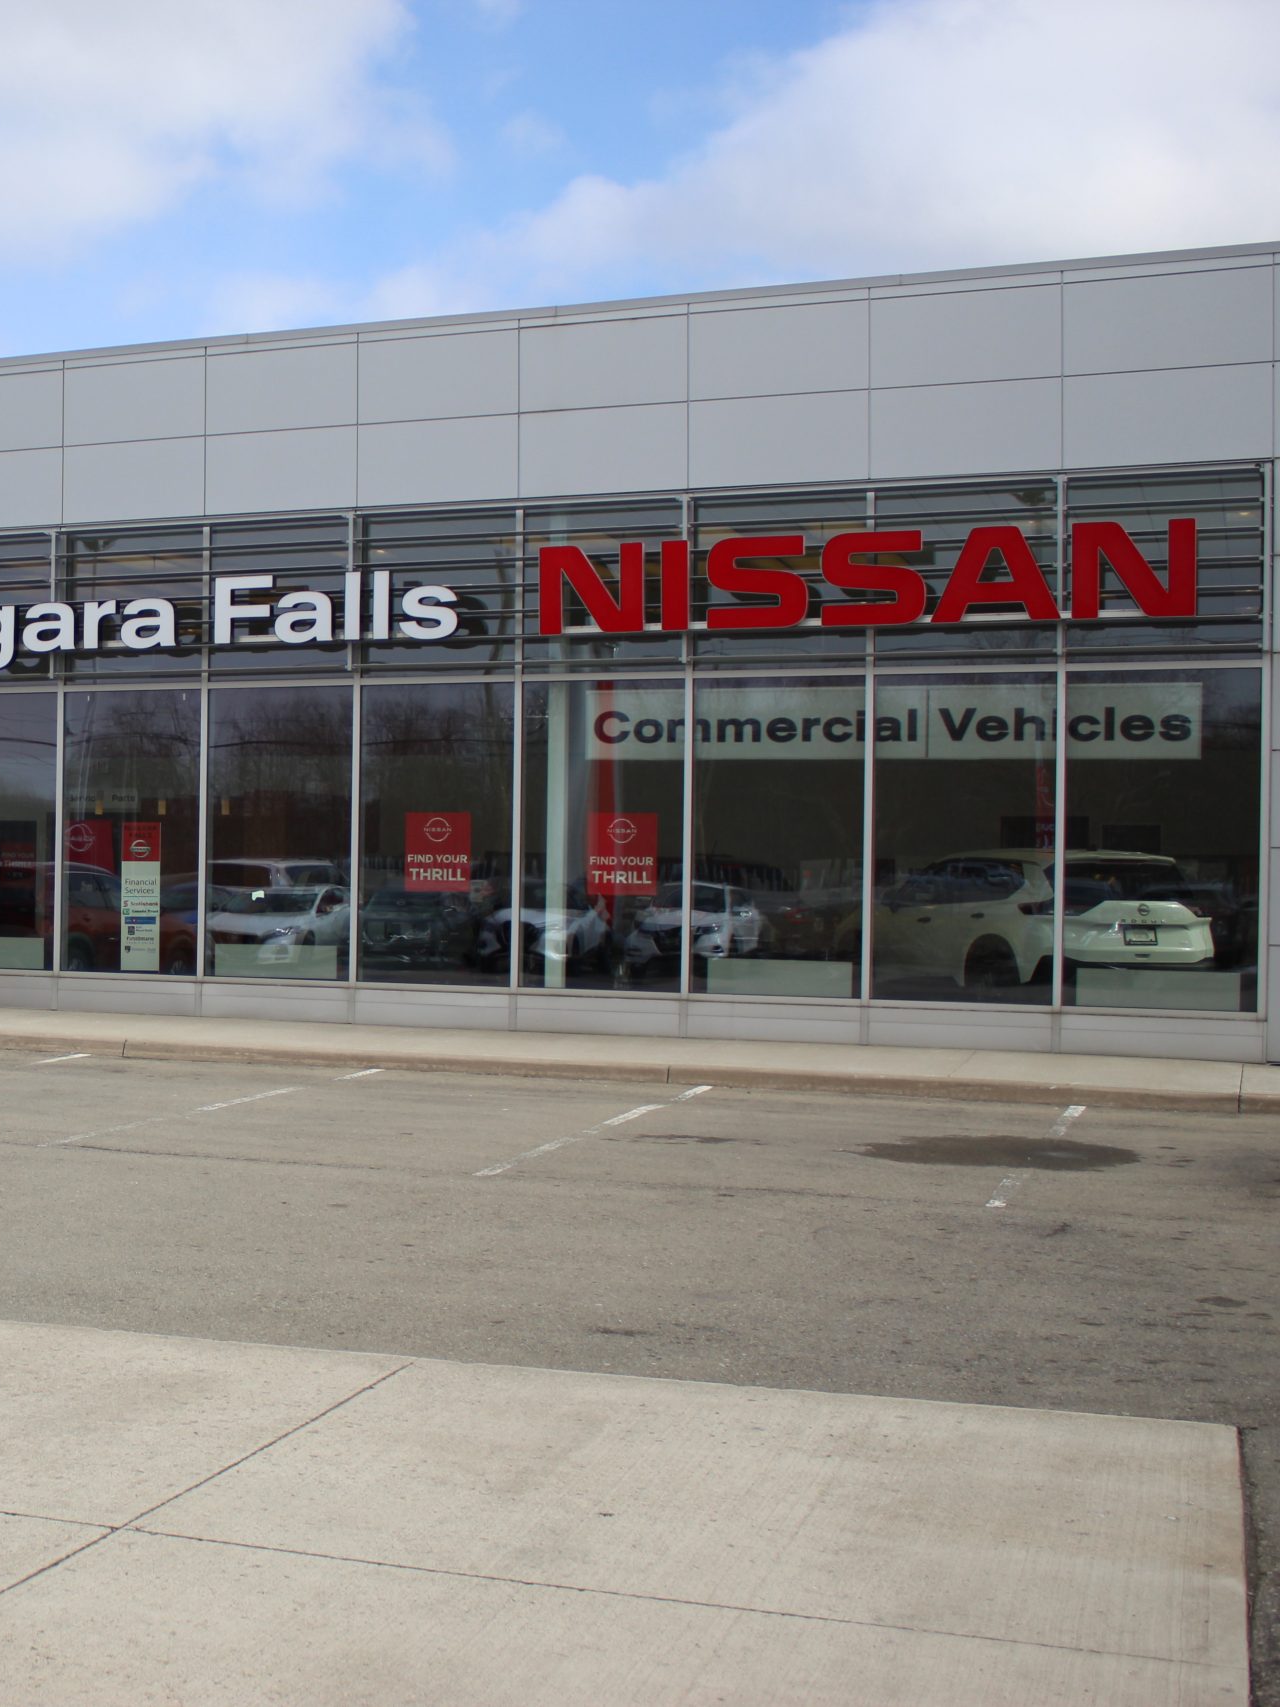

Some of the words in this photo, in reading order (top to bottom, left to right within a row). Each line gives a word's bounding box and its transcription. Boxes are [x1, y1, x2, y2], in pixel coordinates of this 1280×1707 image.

[538, 518, 1196, 635] NISSAN
[214, 570, 458, 645] Falls
[593, 708, 918, 744] Commercial
[407, 854, 433, 863] FIND
[436, 854, 468, 863] YOUR
[589, 856, 617, 865] FIND
[620, 856, 654, 866] YOUR
[409, 868, 466, 881] THRILL
[592, 870, 652, 884] THRILL
[124, 878, 157, 886] Financial
[125, 887, 155, 895] Services
